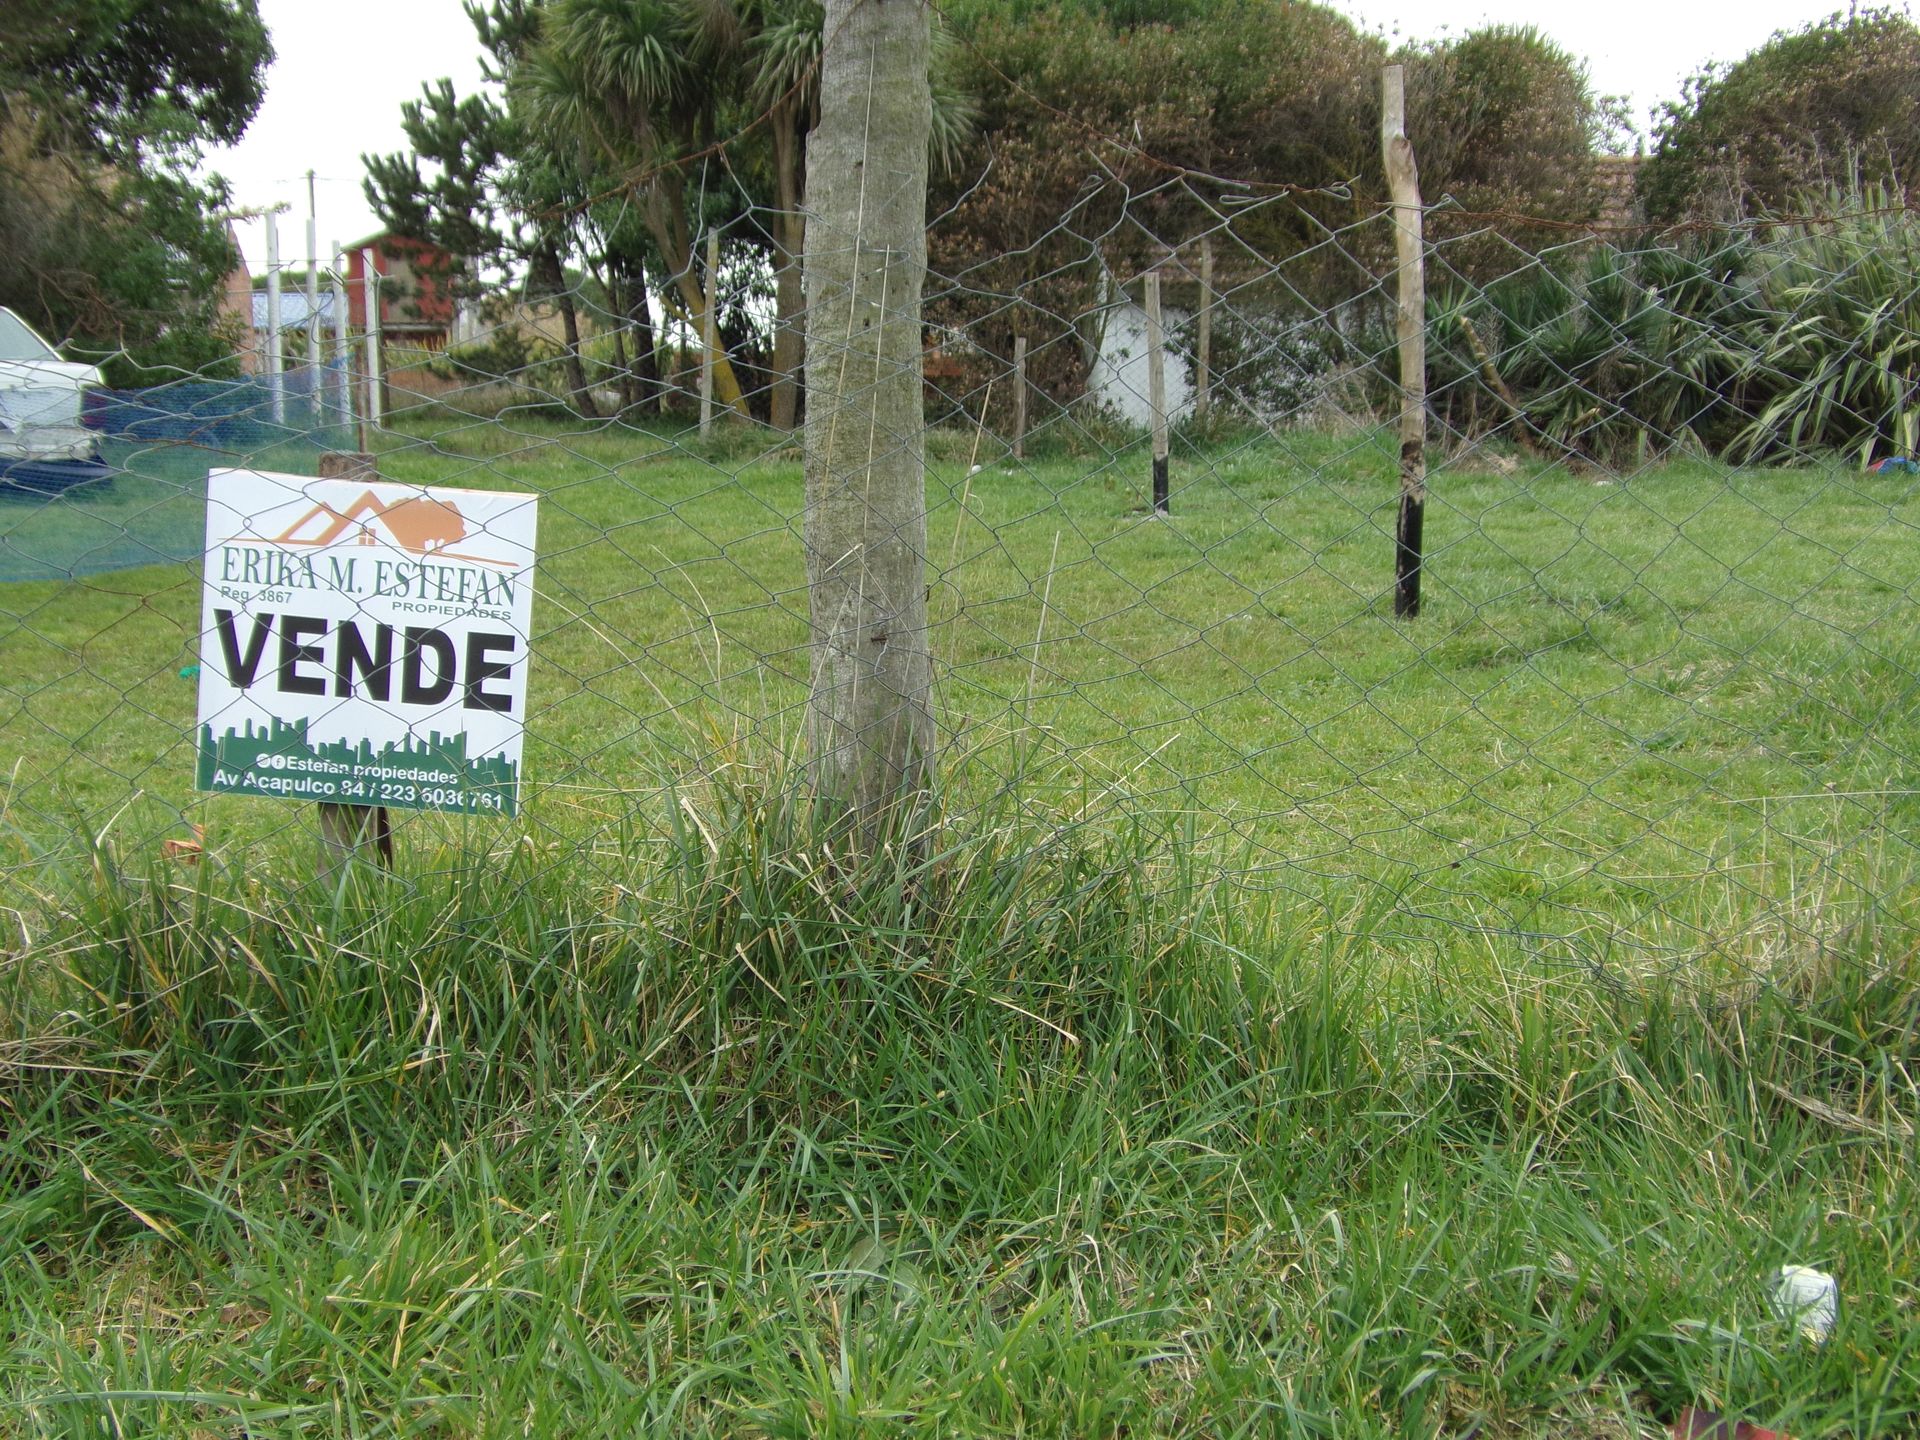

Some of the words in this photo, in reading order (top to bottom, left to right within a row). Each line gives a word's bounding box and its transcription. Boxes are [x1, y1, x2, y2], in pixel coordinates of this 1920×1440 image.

[220, 546, 317, 589] ERIKA
[326, 556, 362, 593] M.
[373, 560, 519, 607] ESTEFAN
[258, 590, 292, 603] 3867
[392, 601, 512, 620] PROPIEDADES
[213, 608, 515, 712] VENDE
[213, 769, 238, 786] Av
[242, 771, 335, 794] Acapulco
[340, 780, 365, 796] 84
[380, 783, 416, 801] 223
[286, 756, 349, 775] Estefan
[353, 765, 458, 784] propiedades
